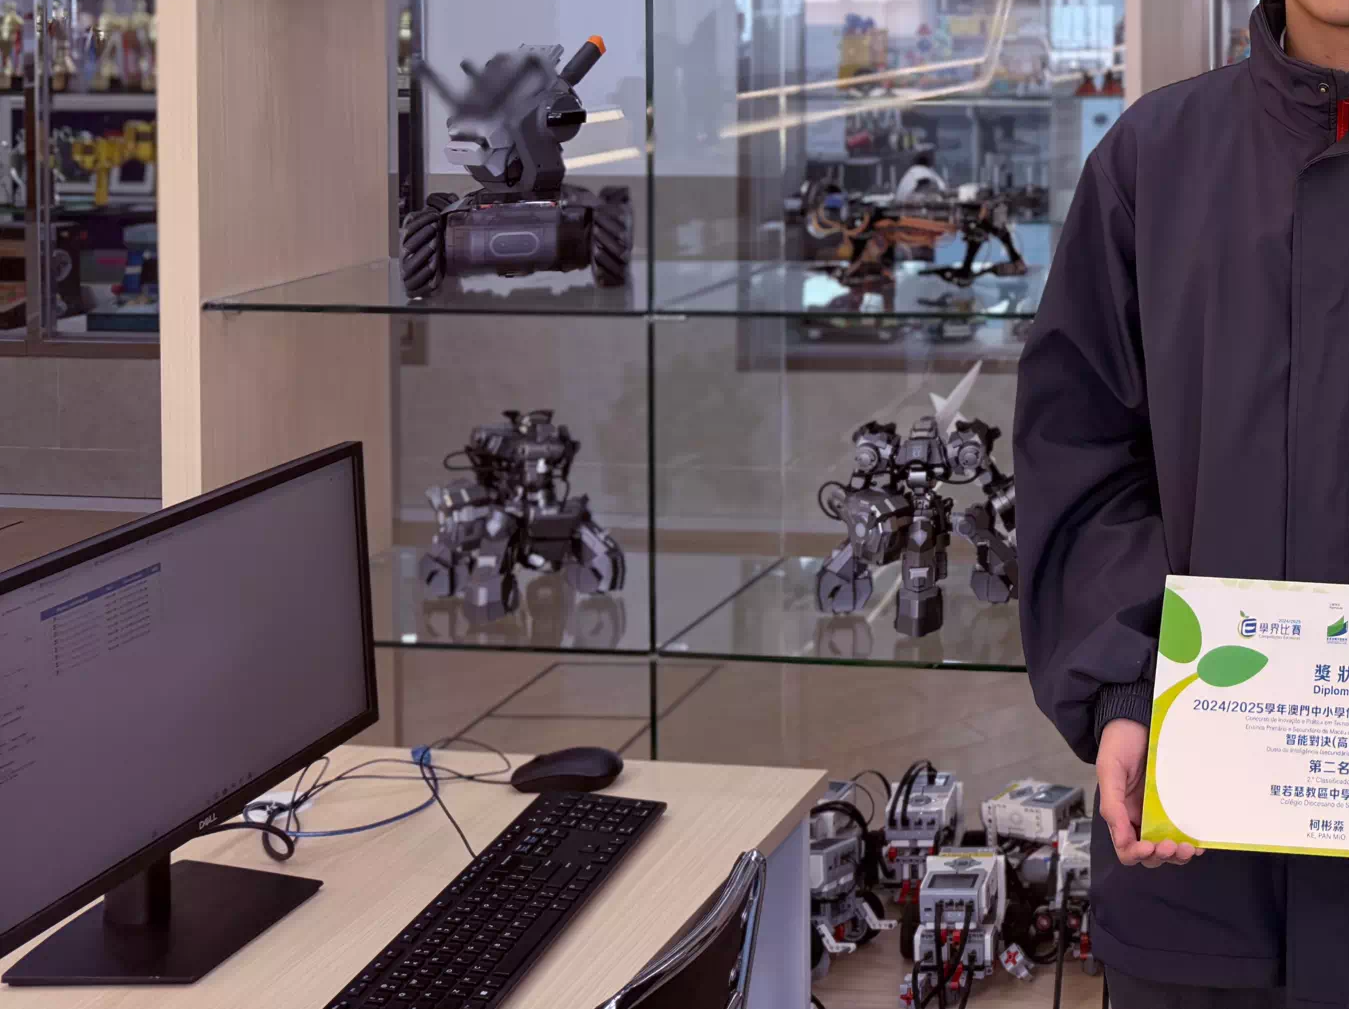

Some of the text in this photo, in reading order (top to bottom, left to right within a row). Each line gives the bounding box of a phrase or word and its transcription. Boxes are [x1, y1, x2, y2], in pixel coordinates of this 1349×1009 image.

[1258, 622, 1302, 637] 學界比賽
[1309, 759, 1349, 776] 第二名
[1279, 798, 1302, 807] Colégio
[1304, 799, 1335, 808] Diocesano
[199, 813, 218, 830] DELL
